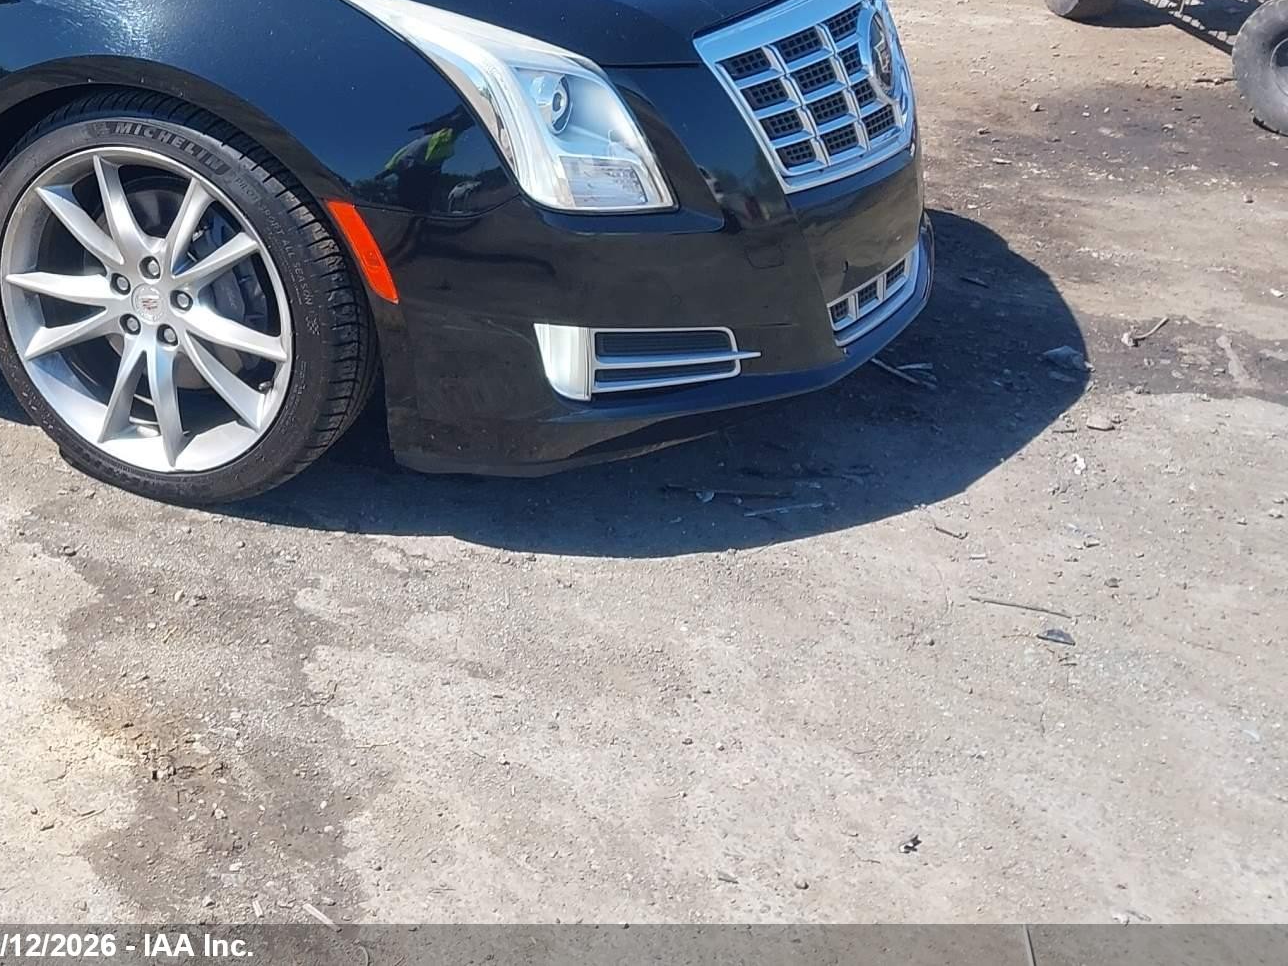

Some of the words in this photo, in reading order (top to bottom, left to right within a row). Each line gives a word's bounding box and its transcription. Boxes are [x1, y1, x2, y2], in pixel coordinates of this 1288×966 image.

[115, 122, 227, 172] MICHELIN
[281, 239, 296, 260] ALL
[293, 261, 313, 305] SEASON
